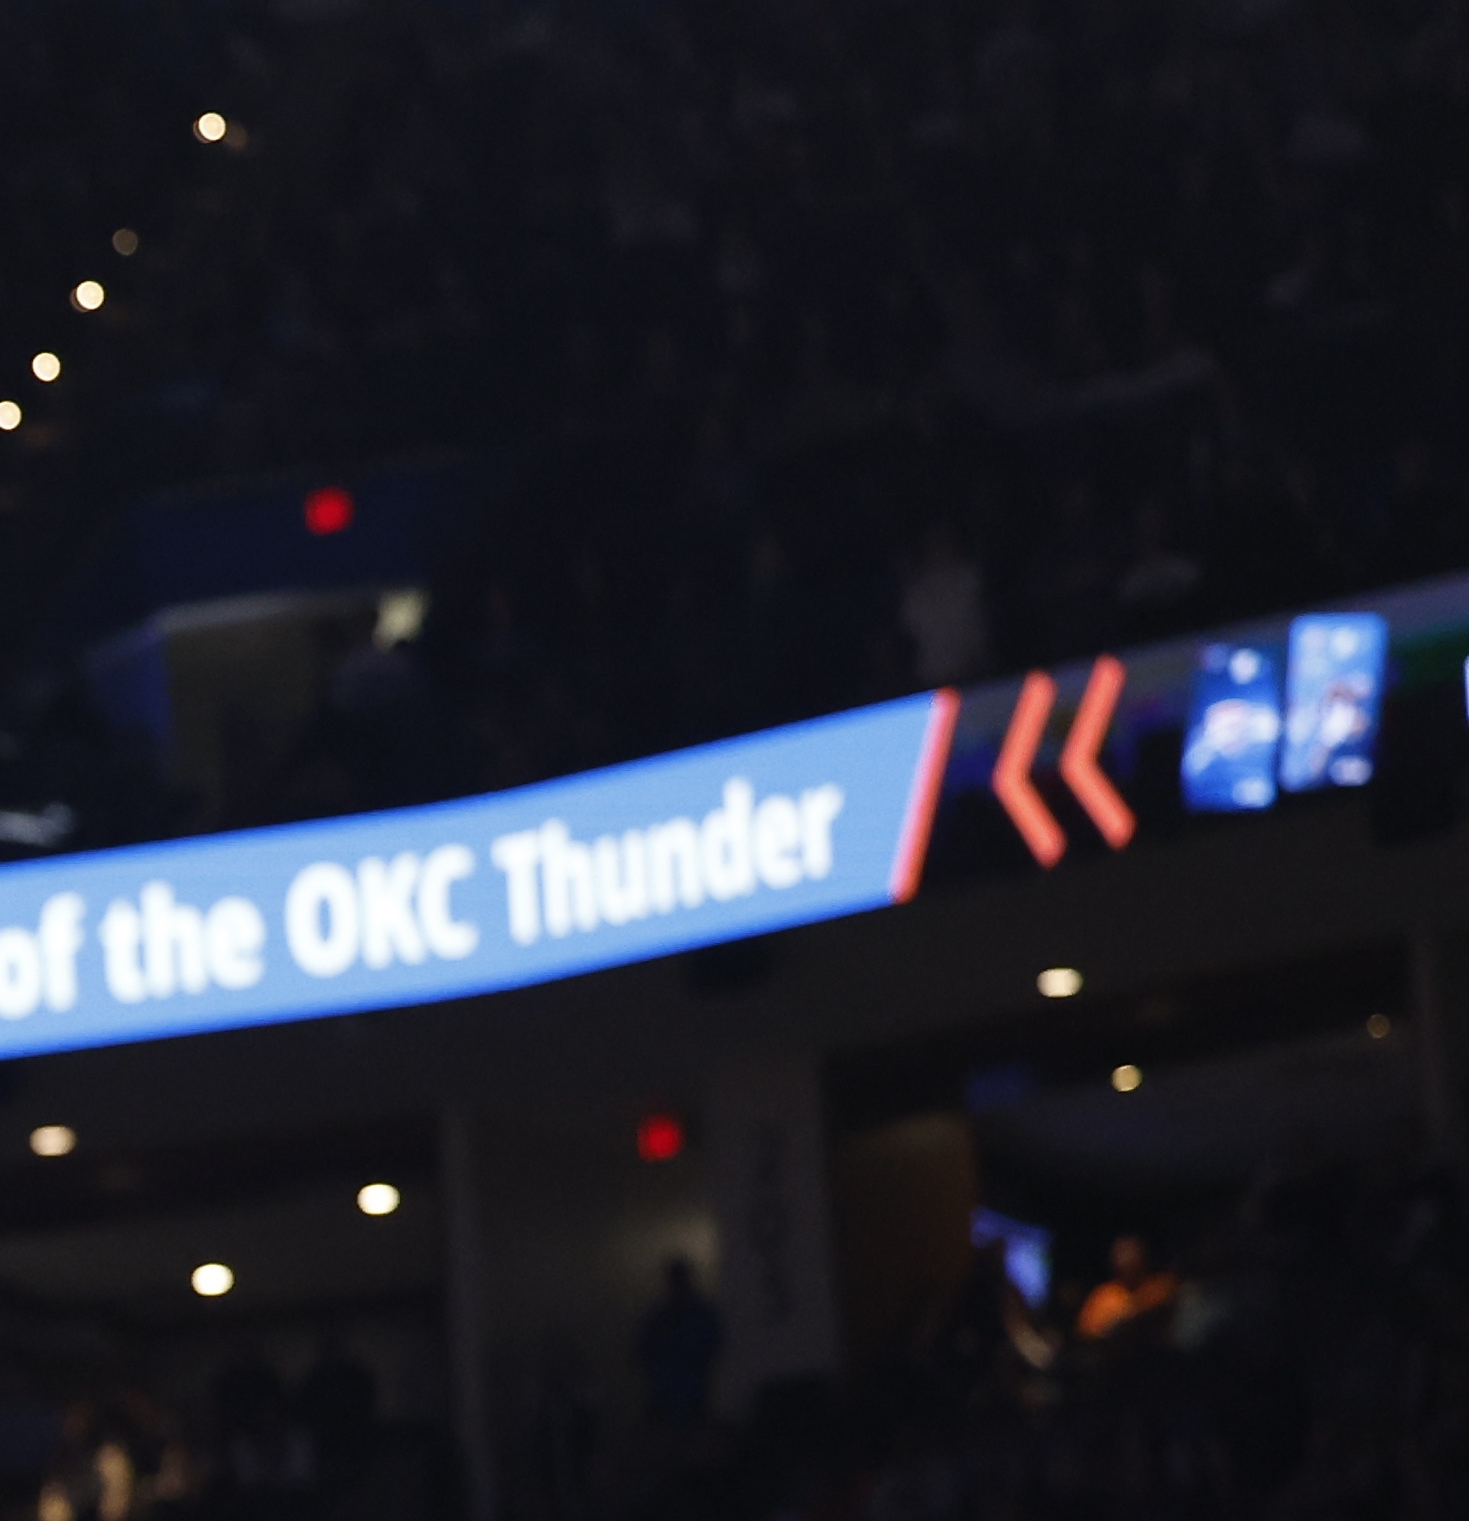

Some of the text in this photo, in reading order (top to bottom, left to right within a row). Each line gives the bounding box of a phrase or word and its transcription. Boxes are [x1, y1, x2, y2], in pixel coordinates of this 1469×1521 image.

[100, 879, 264, 1003] the
[285, 843, 479, 978] OKC
[492, 775, 843, 945] Thunder
